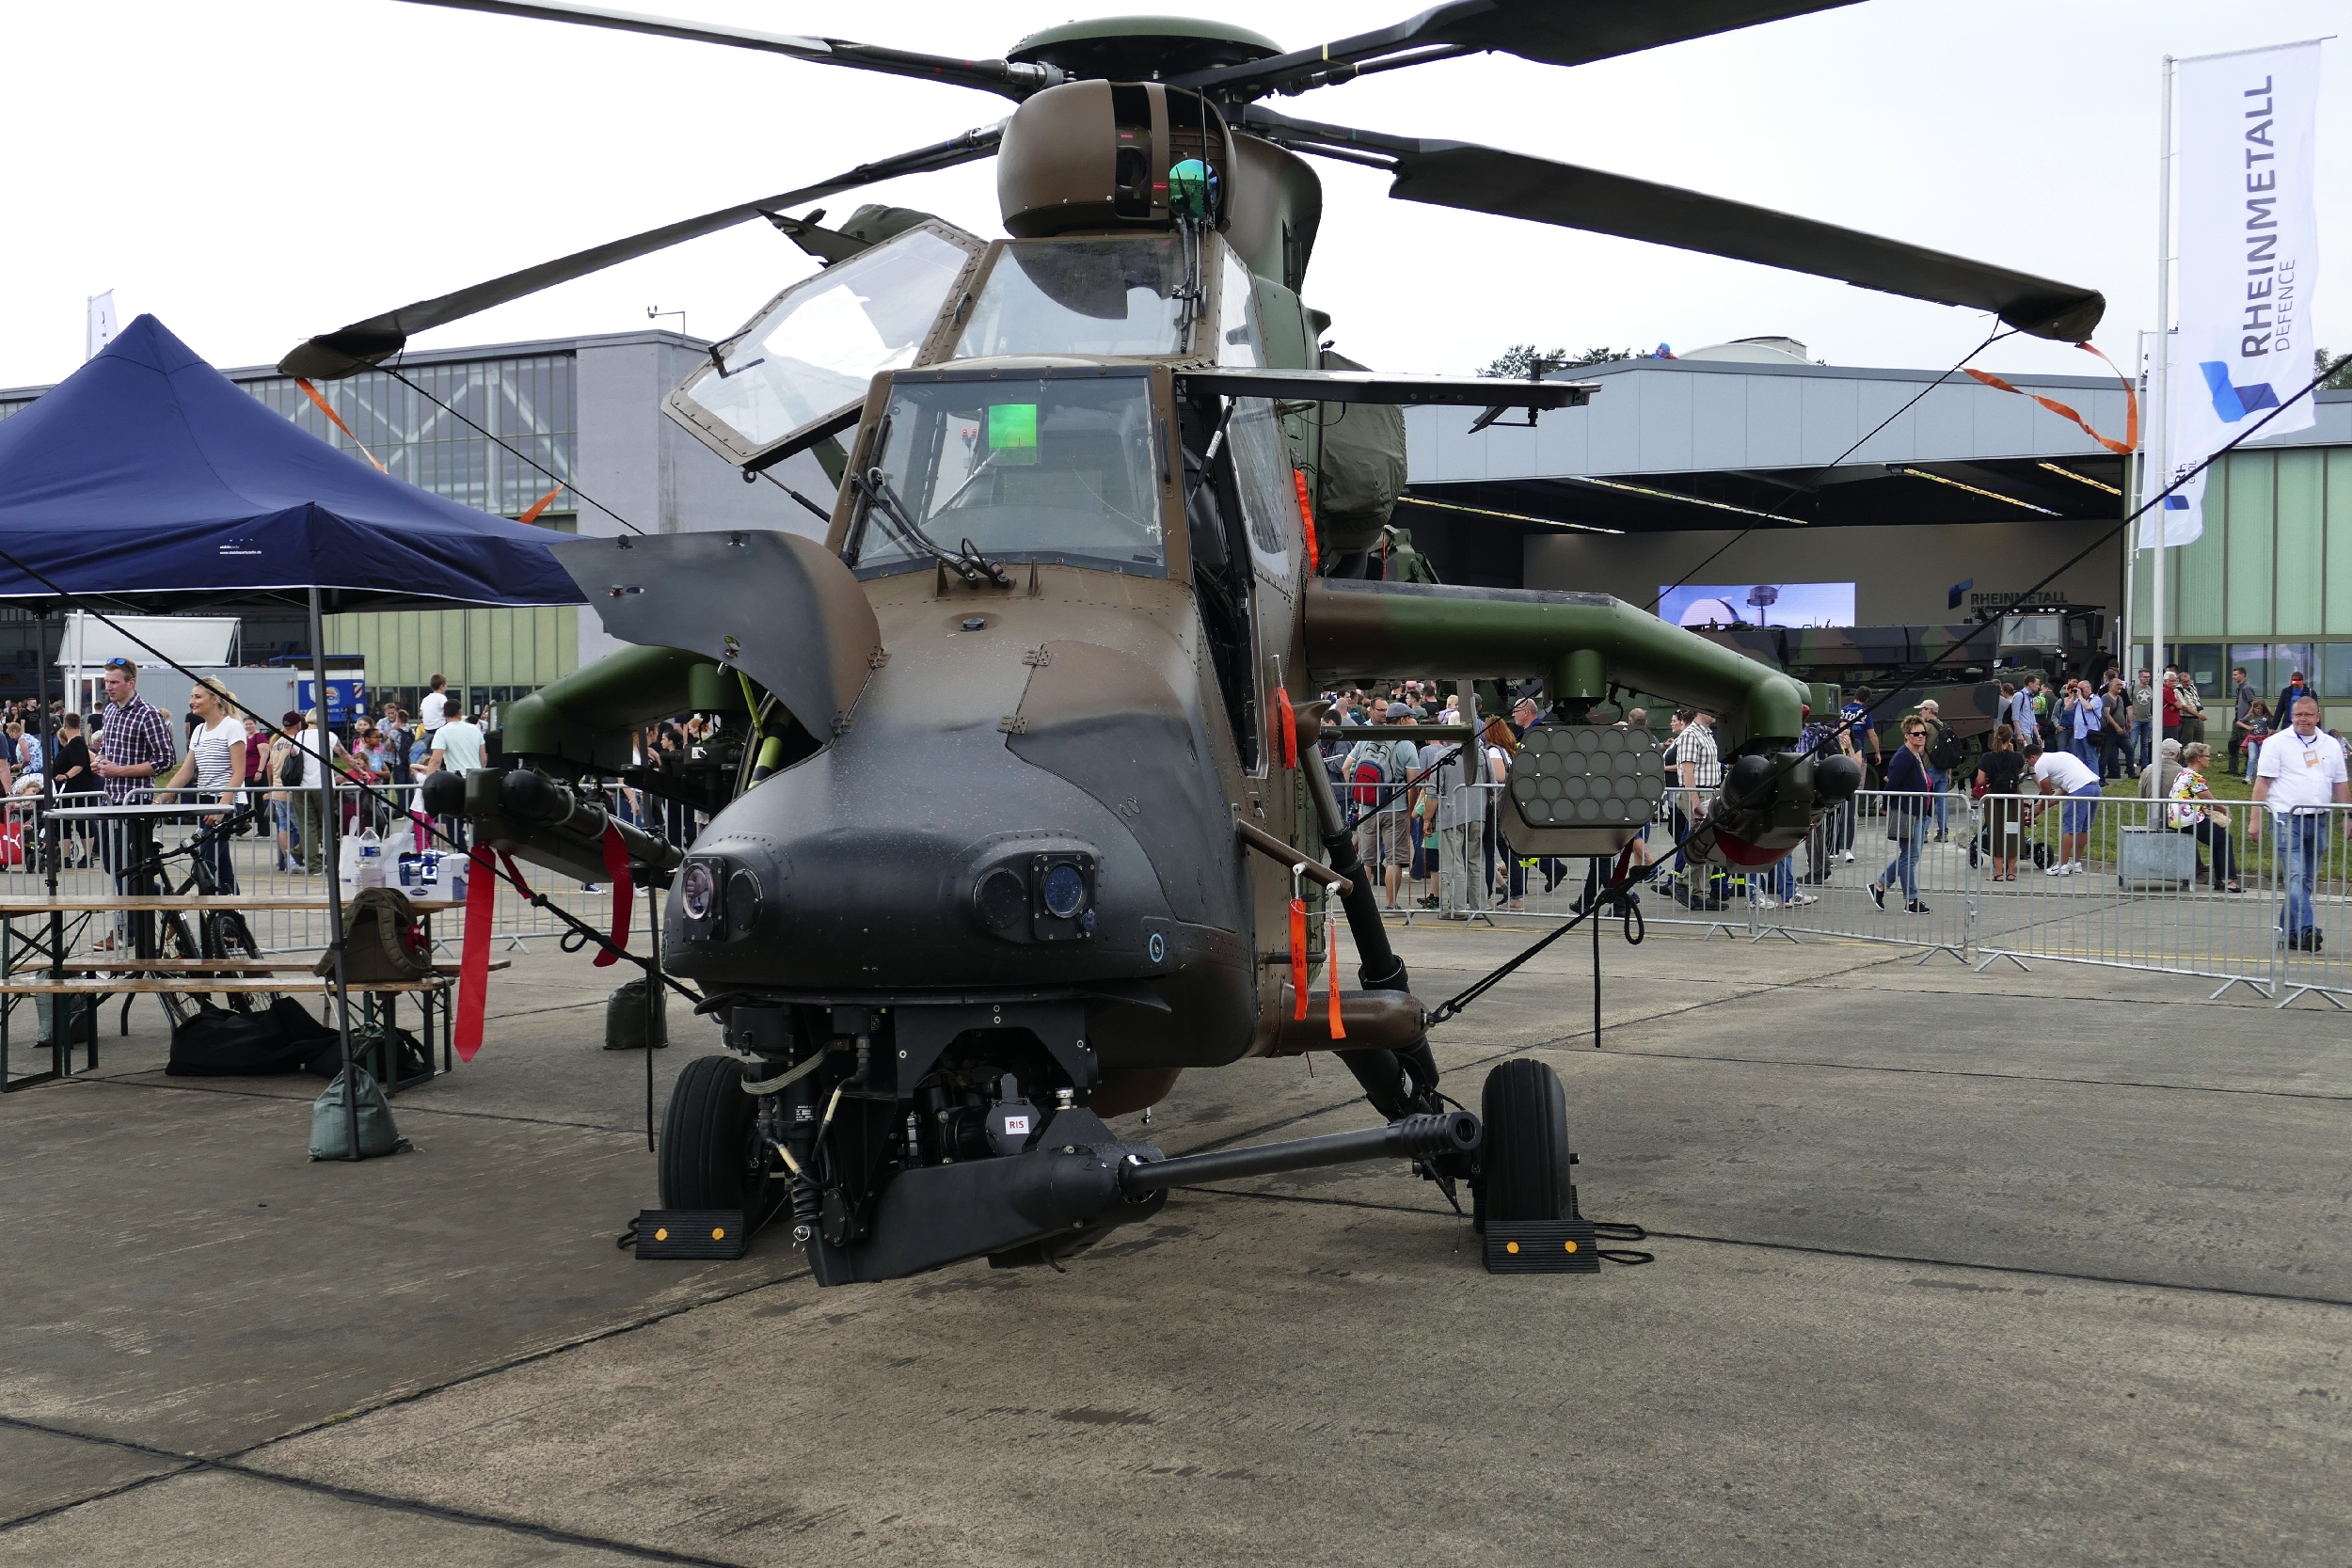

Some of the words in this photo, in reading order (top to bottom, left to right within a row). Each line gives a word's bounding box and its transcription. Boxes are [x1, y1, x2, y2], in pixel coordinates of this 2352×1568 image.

[2241, 74, 2278, 358] RHEINMETALL
[2275, 259, 2296, 353] DEFENCE
[1009, 1120, 1025, 1129] RIS
